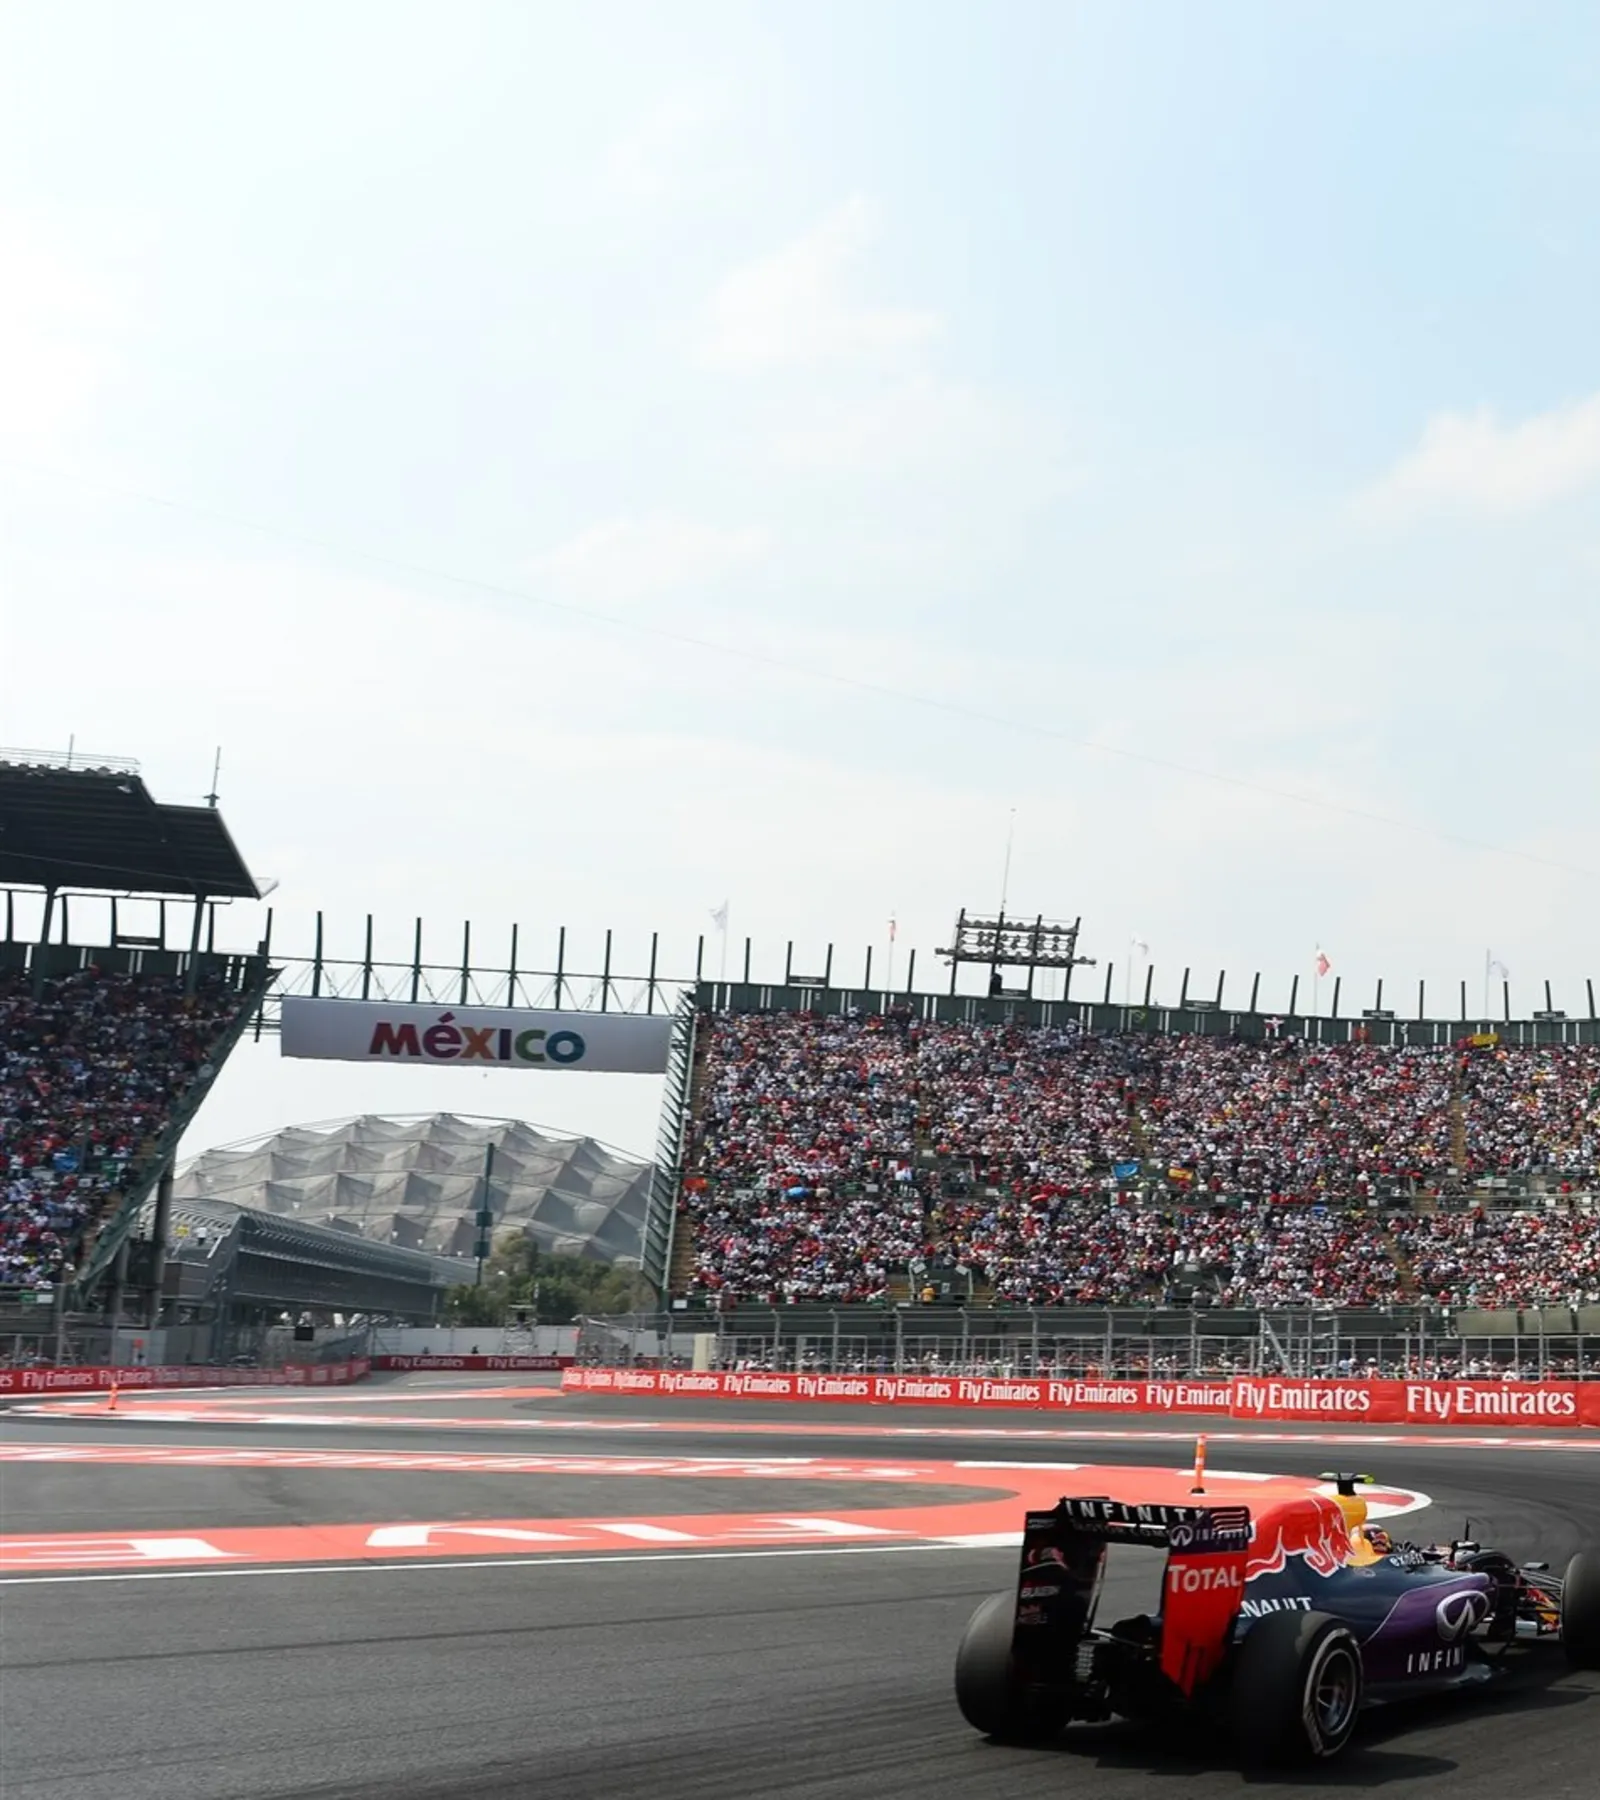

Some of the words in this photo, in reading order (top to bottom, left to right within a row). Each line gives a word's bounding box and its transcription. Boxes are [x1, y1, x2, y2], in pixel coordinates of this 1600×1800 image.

[413, 1357, 464, 1368] Emirates
[509, 1357, 560, 1368] Emirates
[22, 1371, 45, 1390] Fly
[46, 1371, 94, 1387] Emirates
[659, 1373, 675, 1393] Fly
[676, 1373, 719, 1391] Emirates
[723, 1375, 742, 1395] Fly
[743, 1375, 791, 1393] Emirates
[797, 1377, 818, 1398] Fly
[818, 1377, 868, 1396] Emirates
[875, 1379, 897, 1400] Fly
[897, 1379, 952, 1399] Emirates
[959, 1381, 982, 1403] Fly
[983, 1382, 1040, 1401] Emirates
[1049, 1383, 1074, 1406] Fly
[1075, 1383, 1139, 1405] Emirates
[1146, 1384, 1174, 1409] Fly
[1176, 1384, 1233, 1406] Emirat
[1235, 1382, 1267, 1414] Fly
[1269, 1381, 1370, 1412] Emirates
[1407, 1386, 1452, 1419] Fly
[1455, 1384, 1577, 1416] Emirates
[1407, 1647, 1460, 1673] INFIN
